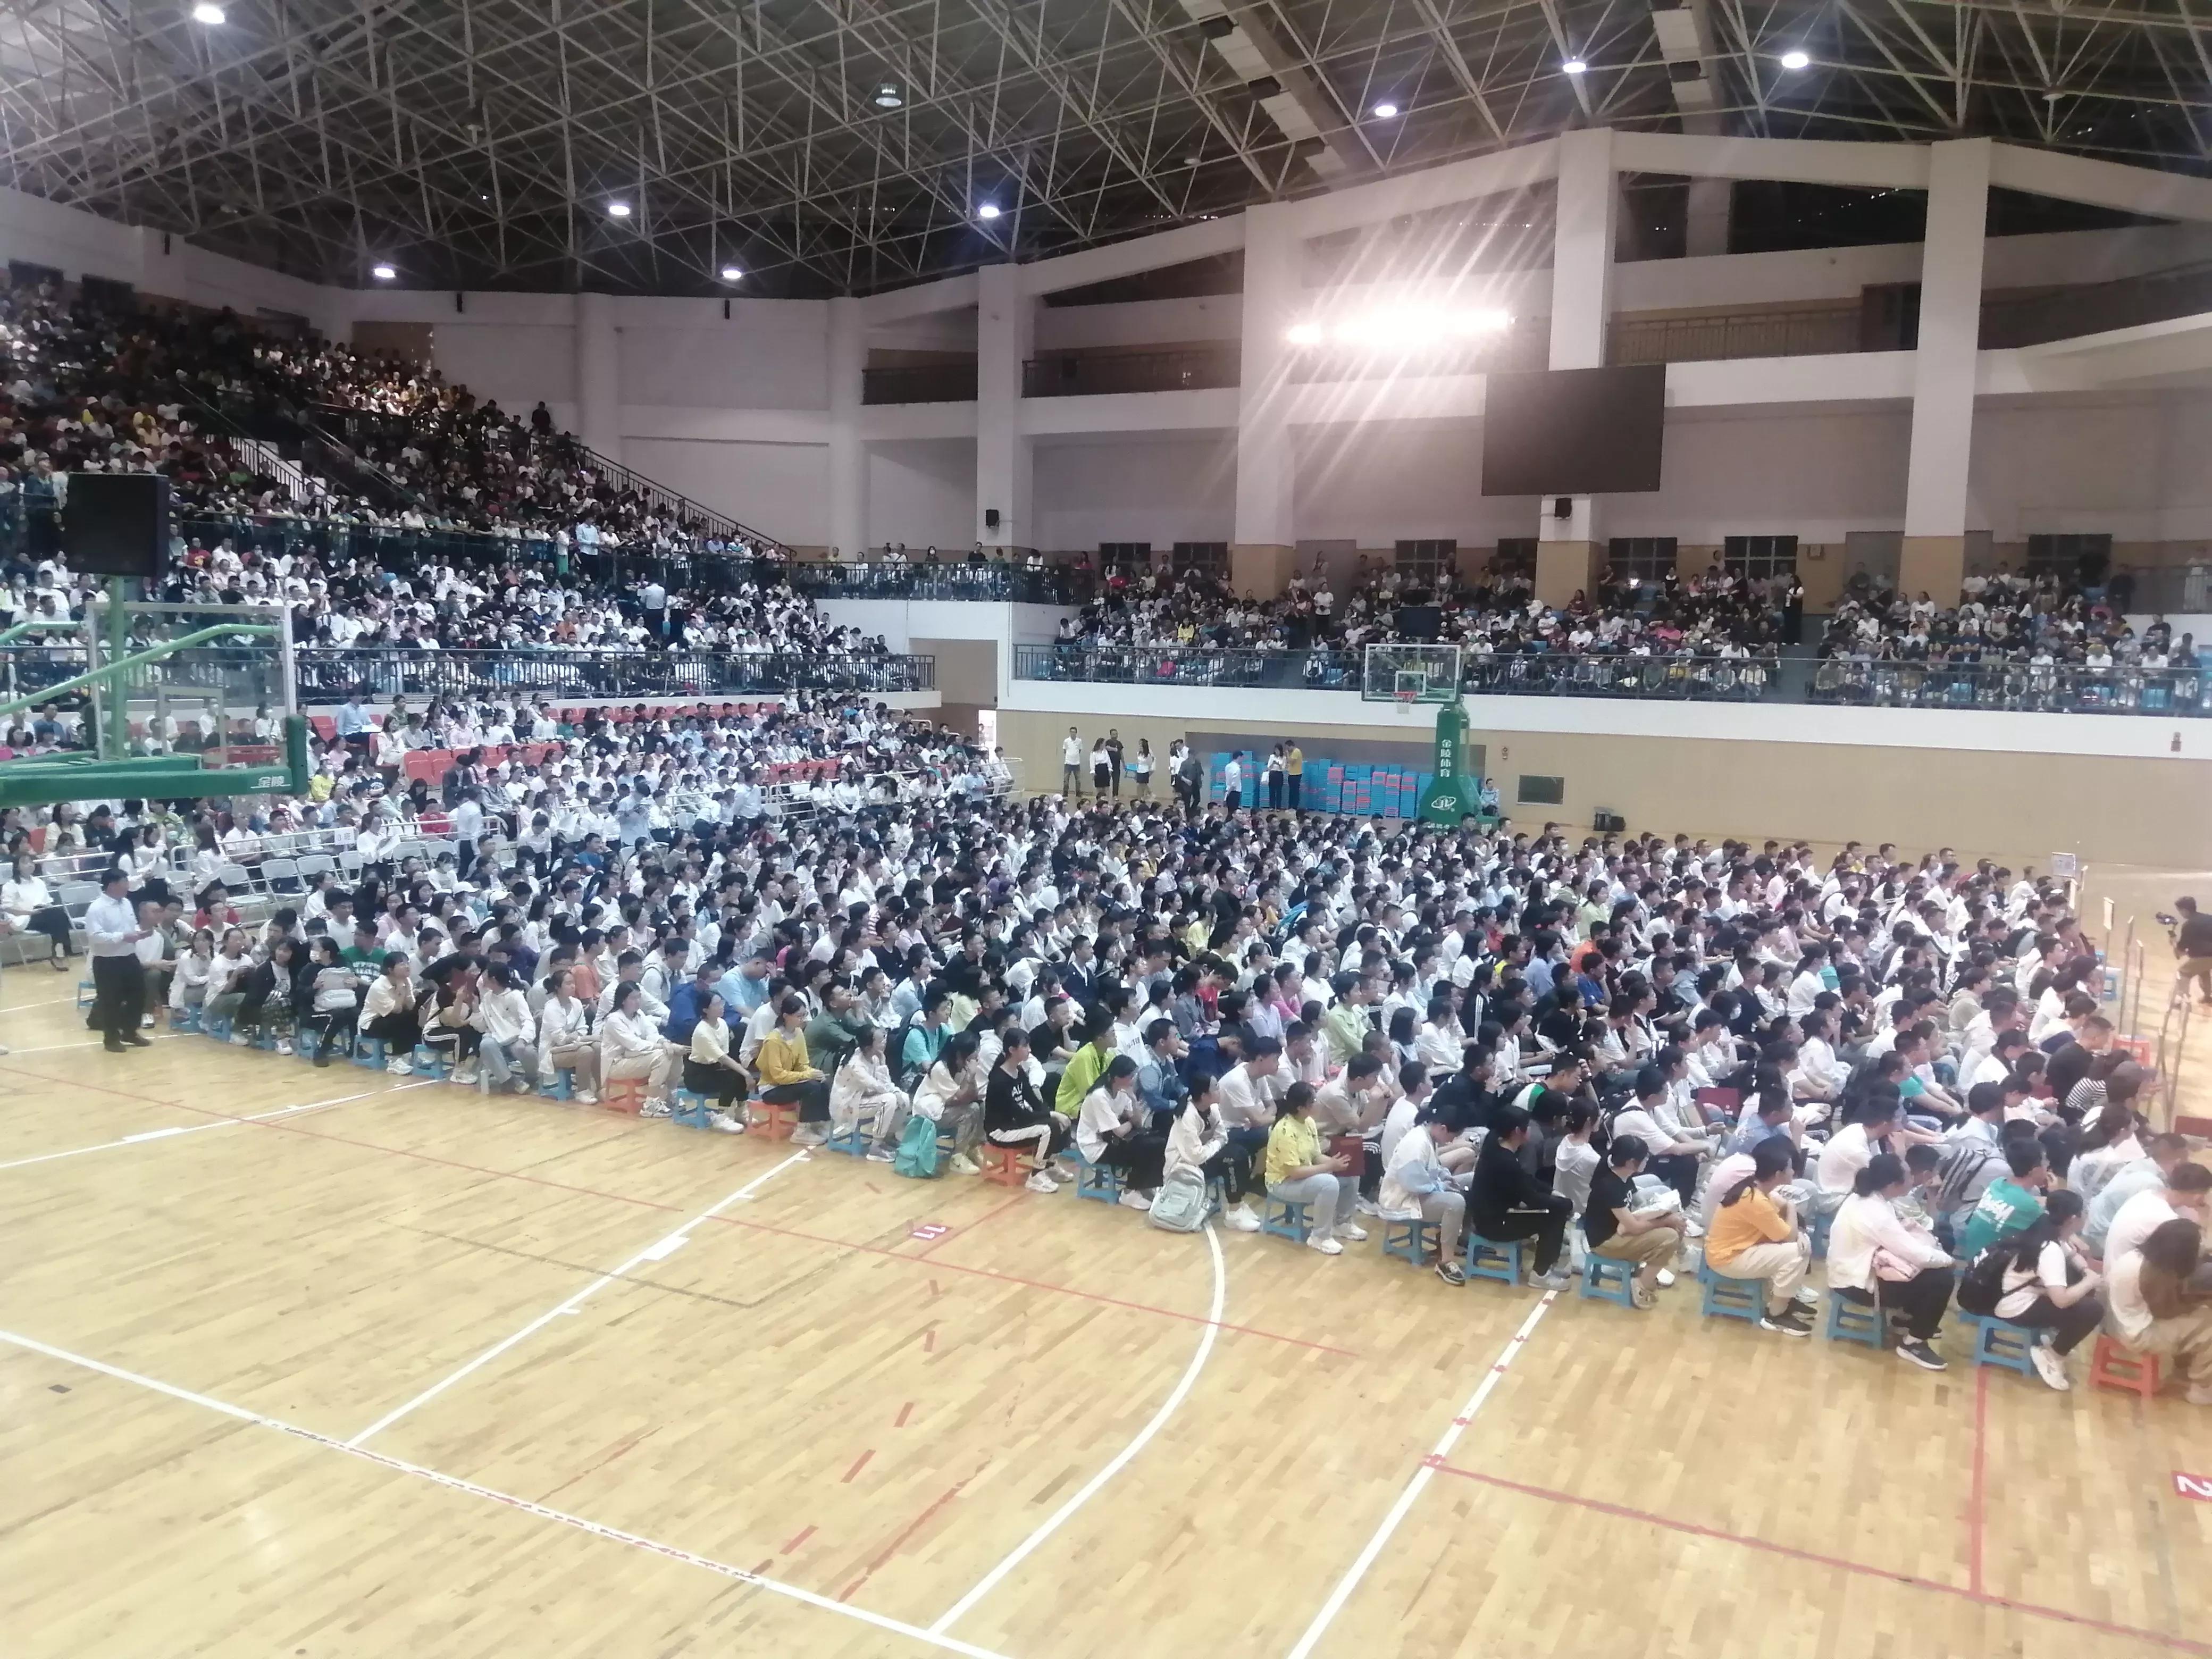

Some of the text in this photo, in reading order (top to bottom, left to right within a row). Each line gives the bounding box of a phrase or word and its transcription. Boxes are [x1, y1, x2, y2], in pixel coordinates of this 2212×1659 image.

[1440, 739, 1452, 777] 金陵体育
[258, 775, 284, 787] 金陵
